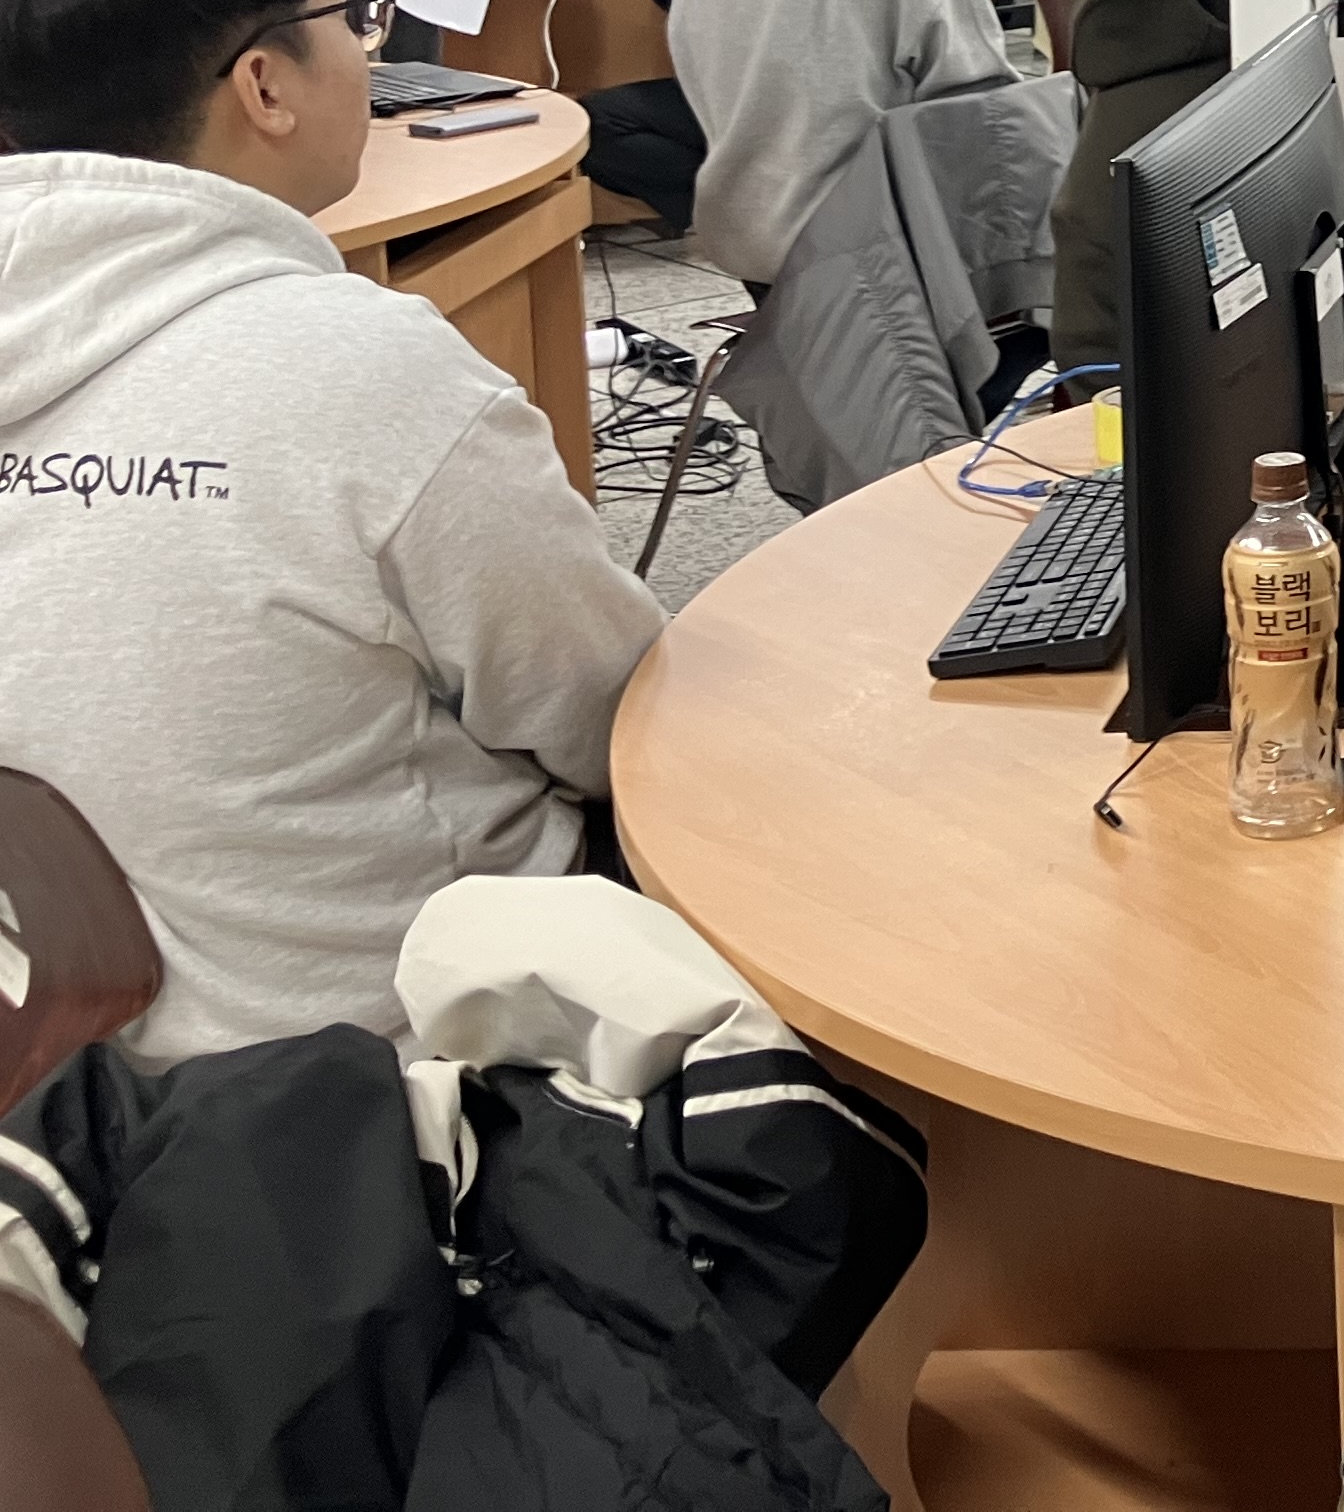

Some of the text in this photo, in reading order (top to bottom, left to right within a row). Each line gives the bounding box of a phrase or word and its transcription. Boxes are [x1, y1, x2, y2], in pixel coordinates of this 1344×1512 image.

[0, 453, 228, 509] BASQUIAT
[1250, 571, 1311, 605] 블랙
[1254, 606, 1310, 636] 보리
